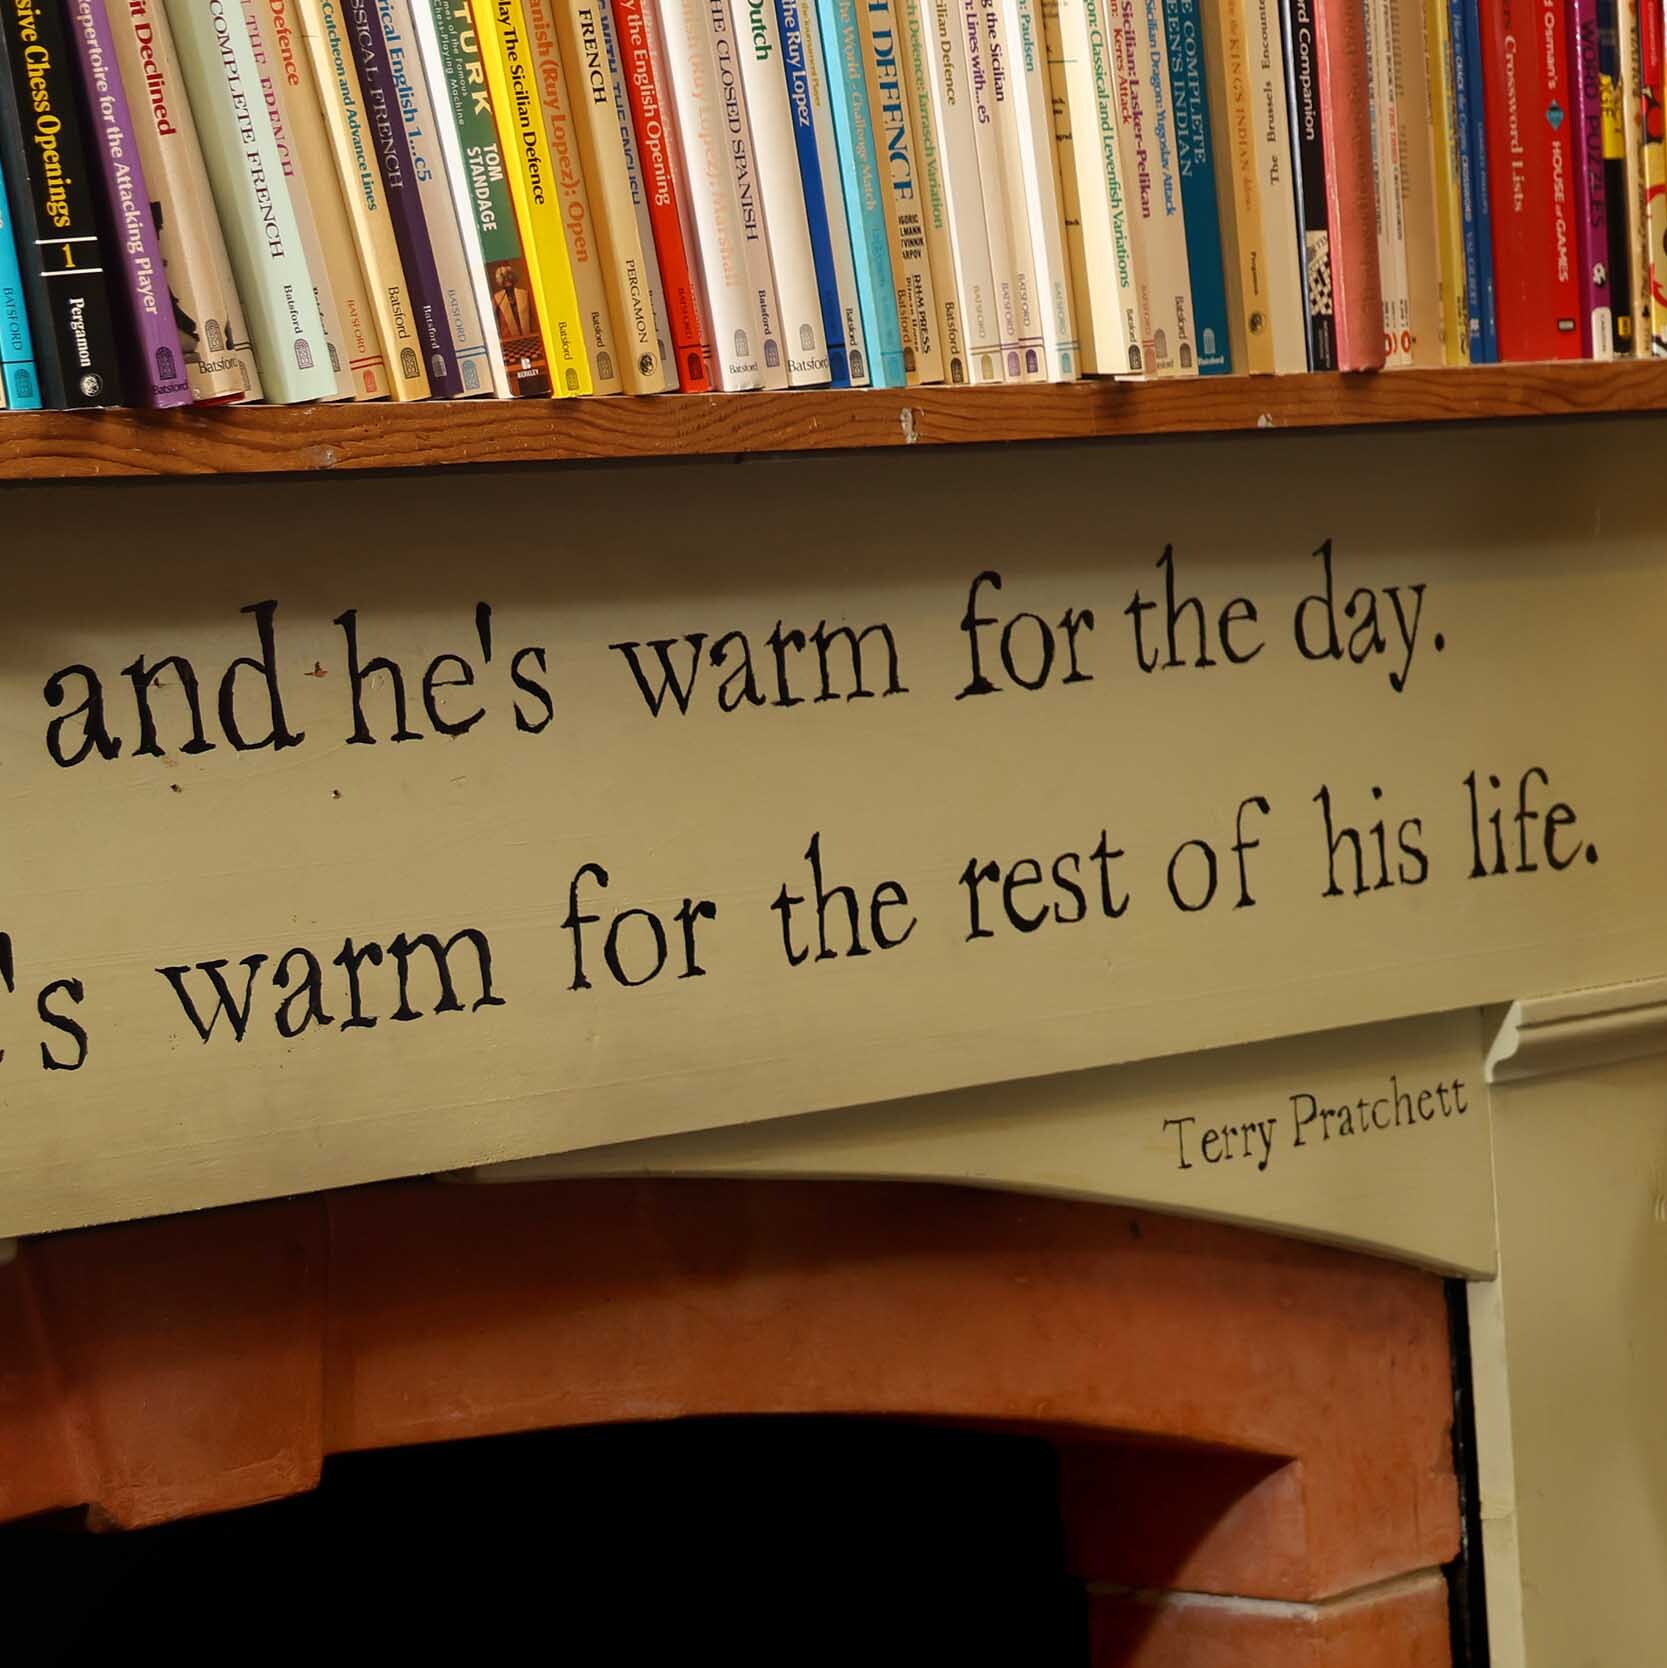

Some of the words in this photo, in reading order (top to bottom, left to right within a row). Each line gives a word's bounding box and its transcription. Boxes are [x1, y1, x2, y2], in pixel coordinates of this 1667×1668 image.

[269, 0, 300, 87] Defence
[503, 27, 519, 62] The
[578, 8, 608, 105] FRENCH
[627, 14, 643, 46] the
[787, 29, 803, 66] Ruy
[965, 14, 979, 54] Lines
[985, 12, 997, 40] the
[1020, 14, 1034, 73] Paulsen
[1112, 28, 1124, 72] Keres
[1121, 1, 1137, 77] Sicilian:
[1544, 12, 1559, 91] Osman's
[25, 45, 51, 113] Chess
[135, 21, 177, 136] Declined
[390, 48, 417, 125] English
[454, 4, 492, 115] TURK
[538, 60, 561, 113] (Ruy
[632, 49, 655, 116] English
[940, 40, 956, 106] Defence
[989, 42, 1006, 102] Sicilian
[1089, 30, 1111, 101] Classical
[1299, 27, 1317, 141] Companion
[99, 96, 115, 123] for
[339, 79, 352, 104] and
[450, 76, 464, 126] Machine
[510, 61, 532, 129] Sicilian
[791, 69, 811, 128] Lopez
[872, 29, 915, 200] DEFENCE
[1099, 102, 1114, 132] and
[1116, 75, 1133, 126] Attack
[1183, 21, 1207, 164] COMPLETE
[1264, 80, 1277, 143] Brussels
[1504, 34, 1525, 154] Crossword
[106, 126, 123, 158] the
[209, 1, 257, 145] COMPLETE
[245, 147, 286, 259] FRENCH
[345, 107, 369, 160] Advance
[370, 88, 403, 190] FRENCH
[548, 114, 580, 197] Lopez):
[716, 38, 742, 134] CLOSED
[732, 138, 759, 242] SPANISH
[1128, 79, 1152, 219] Lasker-Pelikan
[1173, 81, 1193, 177] INDIAN
[34, 115, 71, 228] Openings
[360, 162, 377, 211] Lines
[466, 146, 498, 232] STANDAGE
[483, 142, 500, 183] TOM
[523, 130, 546, 206] Defence
[642, 118, 671, 207] Opening
[1103, 132, 1124, 210] Levenfish
[1270, 154, 1280, 186] The
[1512, 160, 1525, 213] Lists
[1552, 140, 1565, 203] HOUSE
[112, 161, 144, 255] Attacking
[567, 202, 590, 264] Open
[62, 247, 77, 268] 1
[1112, 210, 1131, 289] Variations
[1555, 218, 1569, 283] GAMES
[135, 257, 158, 315] Player
[283, 284, 304, 335] Batsford
[388, 286, 410, 339] Batsford
[625, 258, 648, 344] PERGAMON
[757, 289, 772, 336] Batsford
[897, 289, 912, 343] Batsford
[68, 297, 92, 368] Pergamon
[424, 304, 441, 350] Batsford
[558, 320, 572, 361] Batsford
[591, 310, 605, 348] Batsford
[845, 307, 859, 346] Batsford
[944, 301, 959, 359] Batsford
[729, 361, 758, 376] Batsford
[788, 358, 829, 373] Batsford
[43, 600, 305, 767] and
[333, 601, 555, 747] he's
[608, 617, 909, 718] warm
[955, 570, 1095, 700] for
[1125, 543, 1266, 674] the
[1293, 538, 1448, 692] day.
[155, 925, 507, 1043] warm
[560, 862, 718, 992] for
[770, 831, 918, 968] the
[958, 828, 1131, 943] rest
[1167, 795, 1272, 913] of
[1312, 784, 1430, 899] his
[1461, 766, 1600, 881] life.
[1162, 1114, 1278, 1171] Terry
[1288, 1074, 1470, 1149] Pratchett
